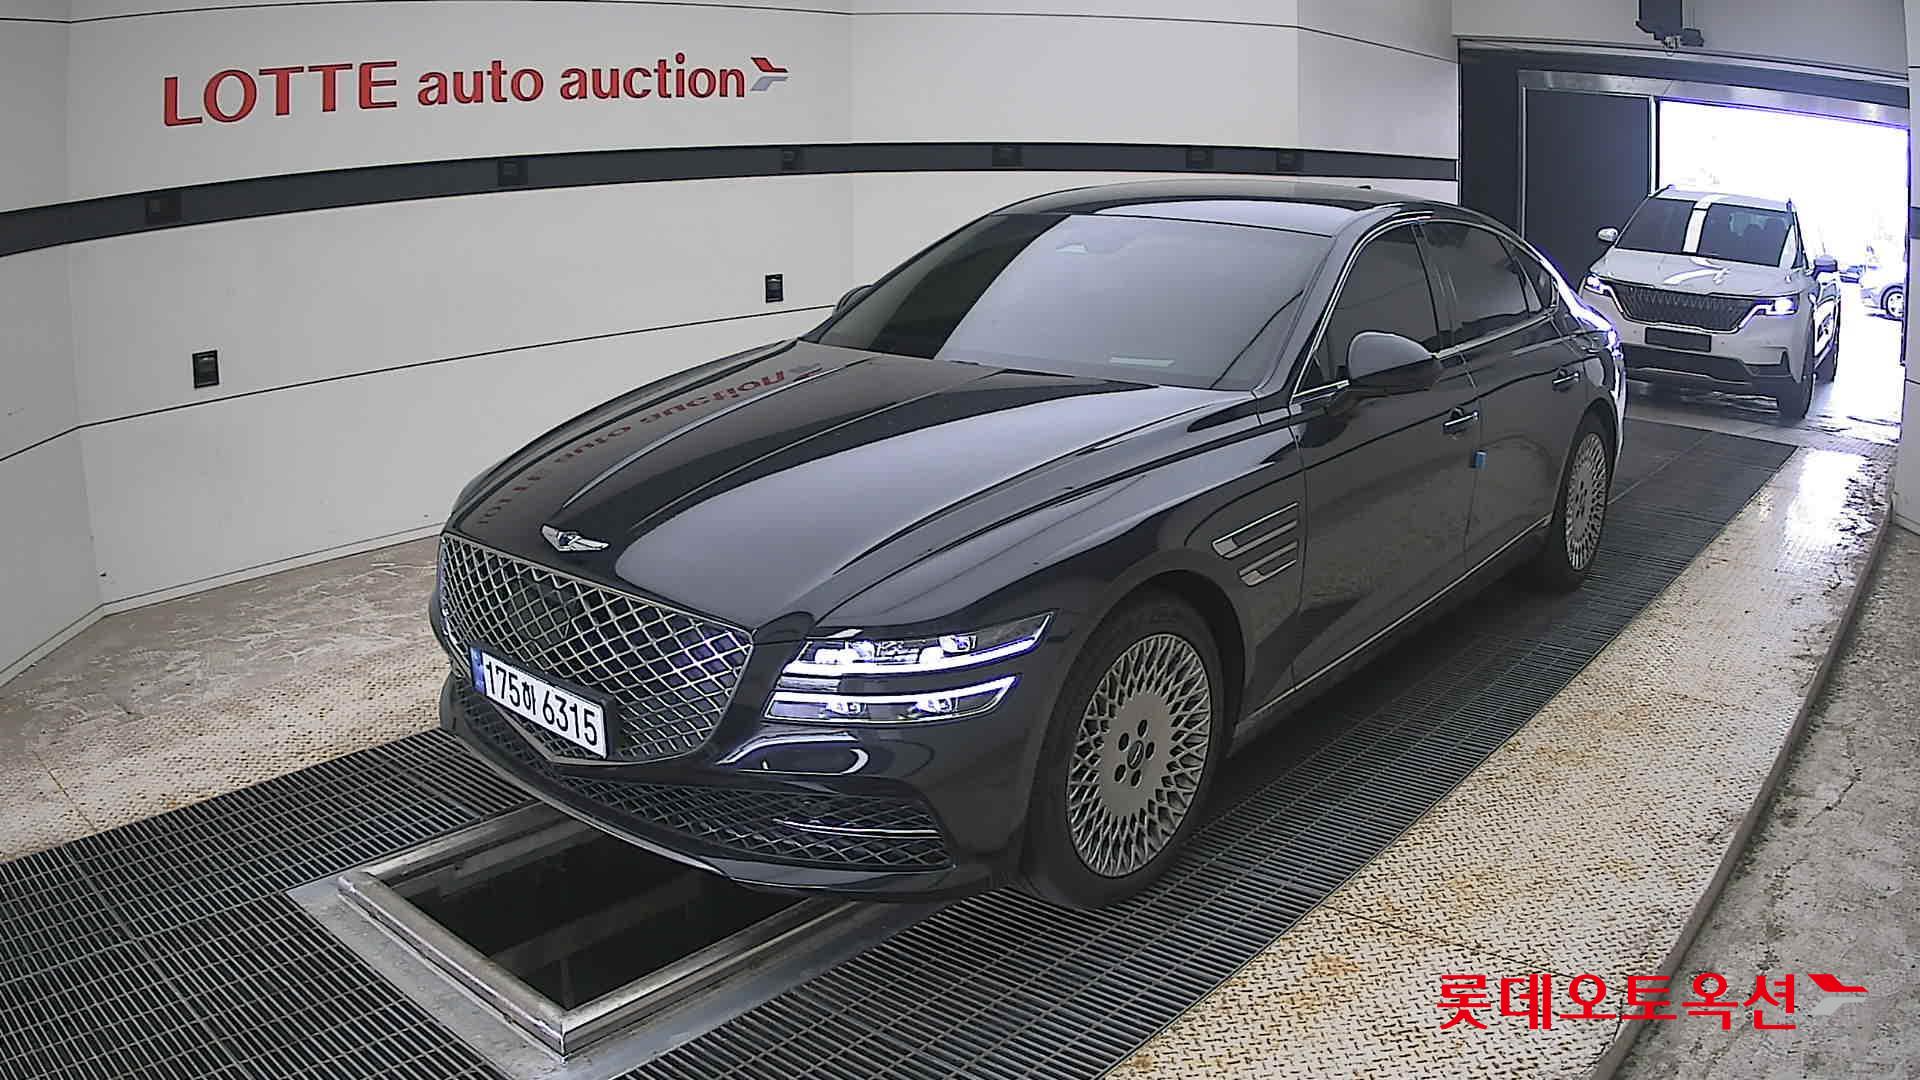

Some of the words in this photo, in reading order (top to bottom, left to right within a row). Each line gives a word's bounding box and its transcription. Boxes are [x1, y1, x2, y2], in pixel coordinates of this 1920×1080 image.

[164, 61, 398, 126] LOTTE
[417, 60, 544, 106] auto
[560, 52, 745, 100] auction
[486, 661, 537, 716] 175하
[543, 691, 598, 746] 6315
